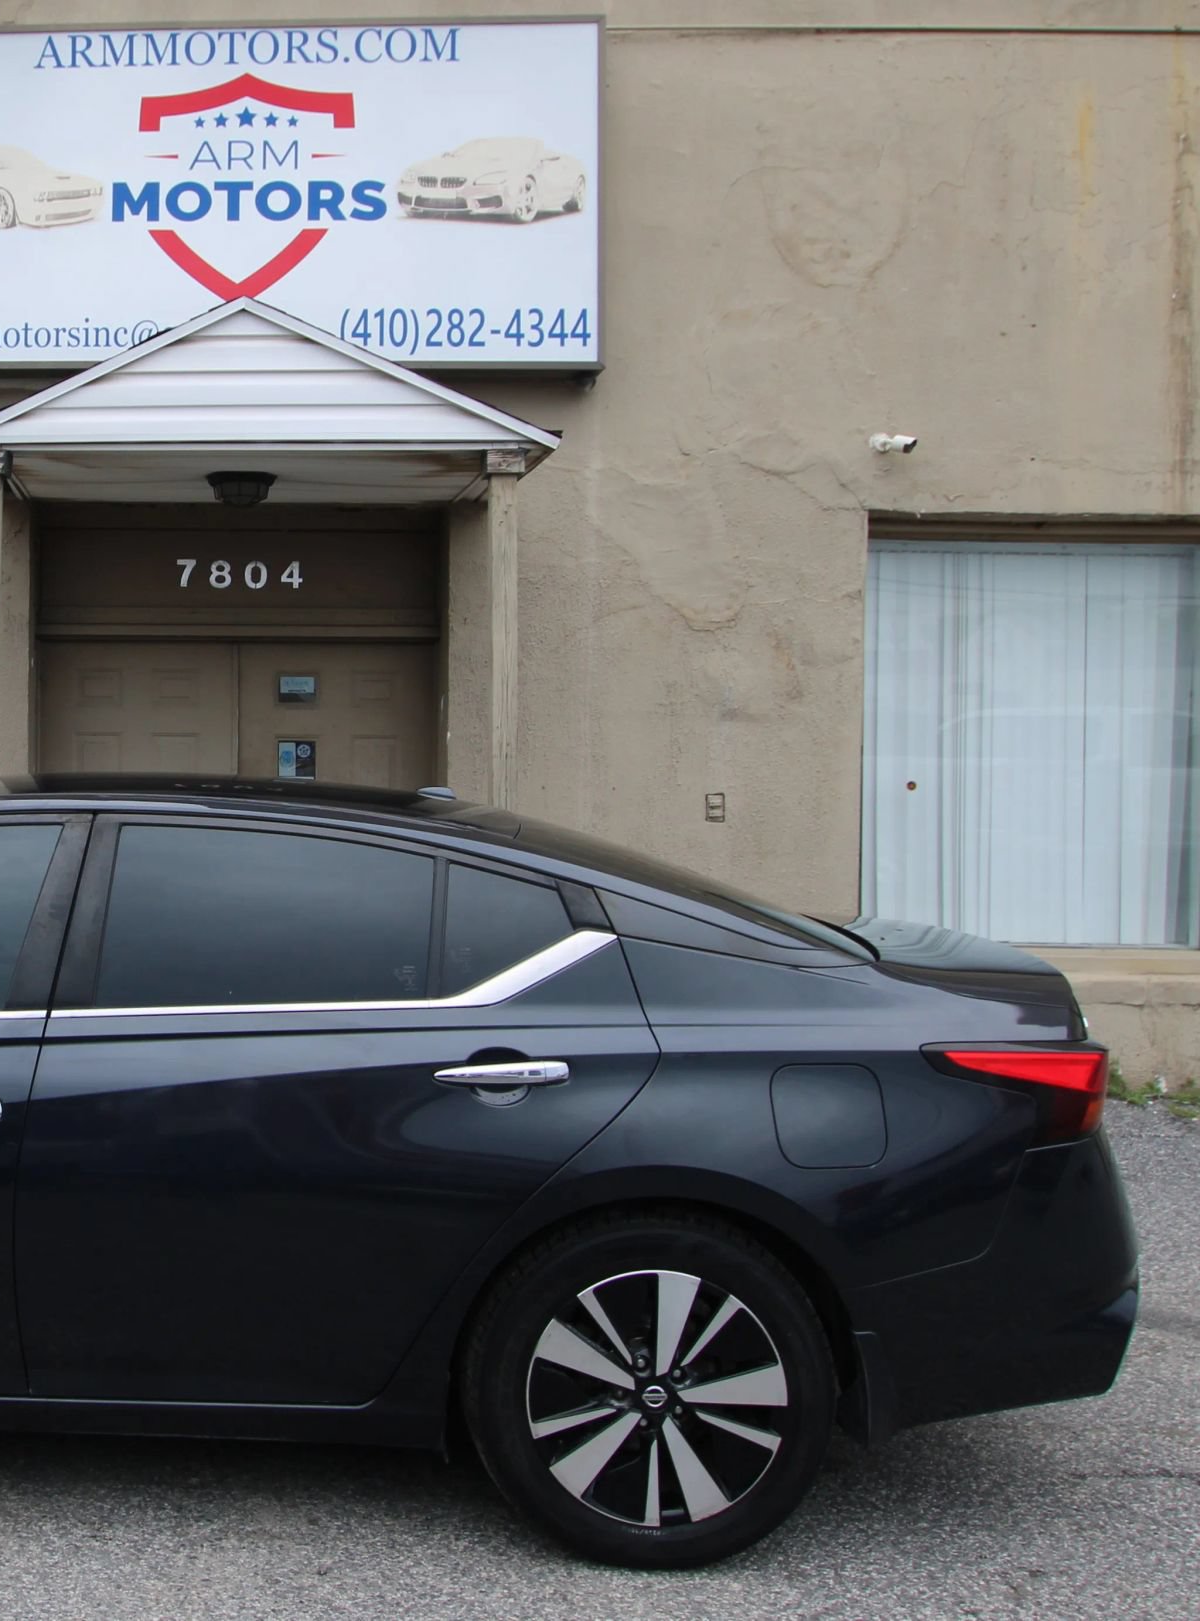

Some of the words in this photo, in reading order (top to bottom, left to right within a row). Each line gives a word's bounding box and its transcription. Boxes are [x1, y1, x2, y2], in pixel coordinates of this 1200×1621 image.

[33, 28, 461, 69] ARMMOTORS.COM
[189, 140, 300, 171] ARM
[111, 180, 388, 222] MOTORS
[340, 308, 591, 355] (410)282-4344
[177, 558, 303, 589] 7804
